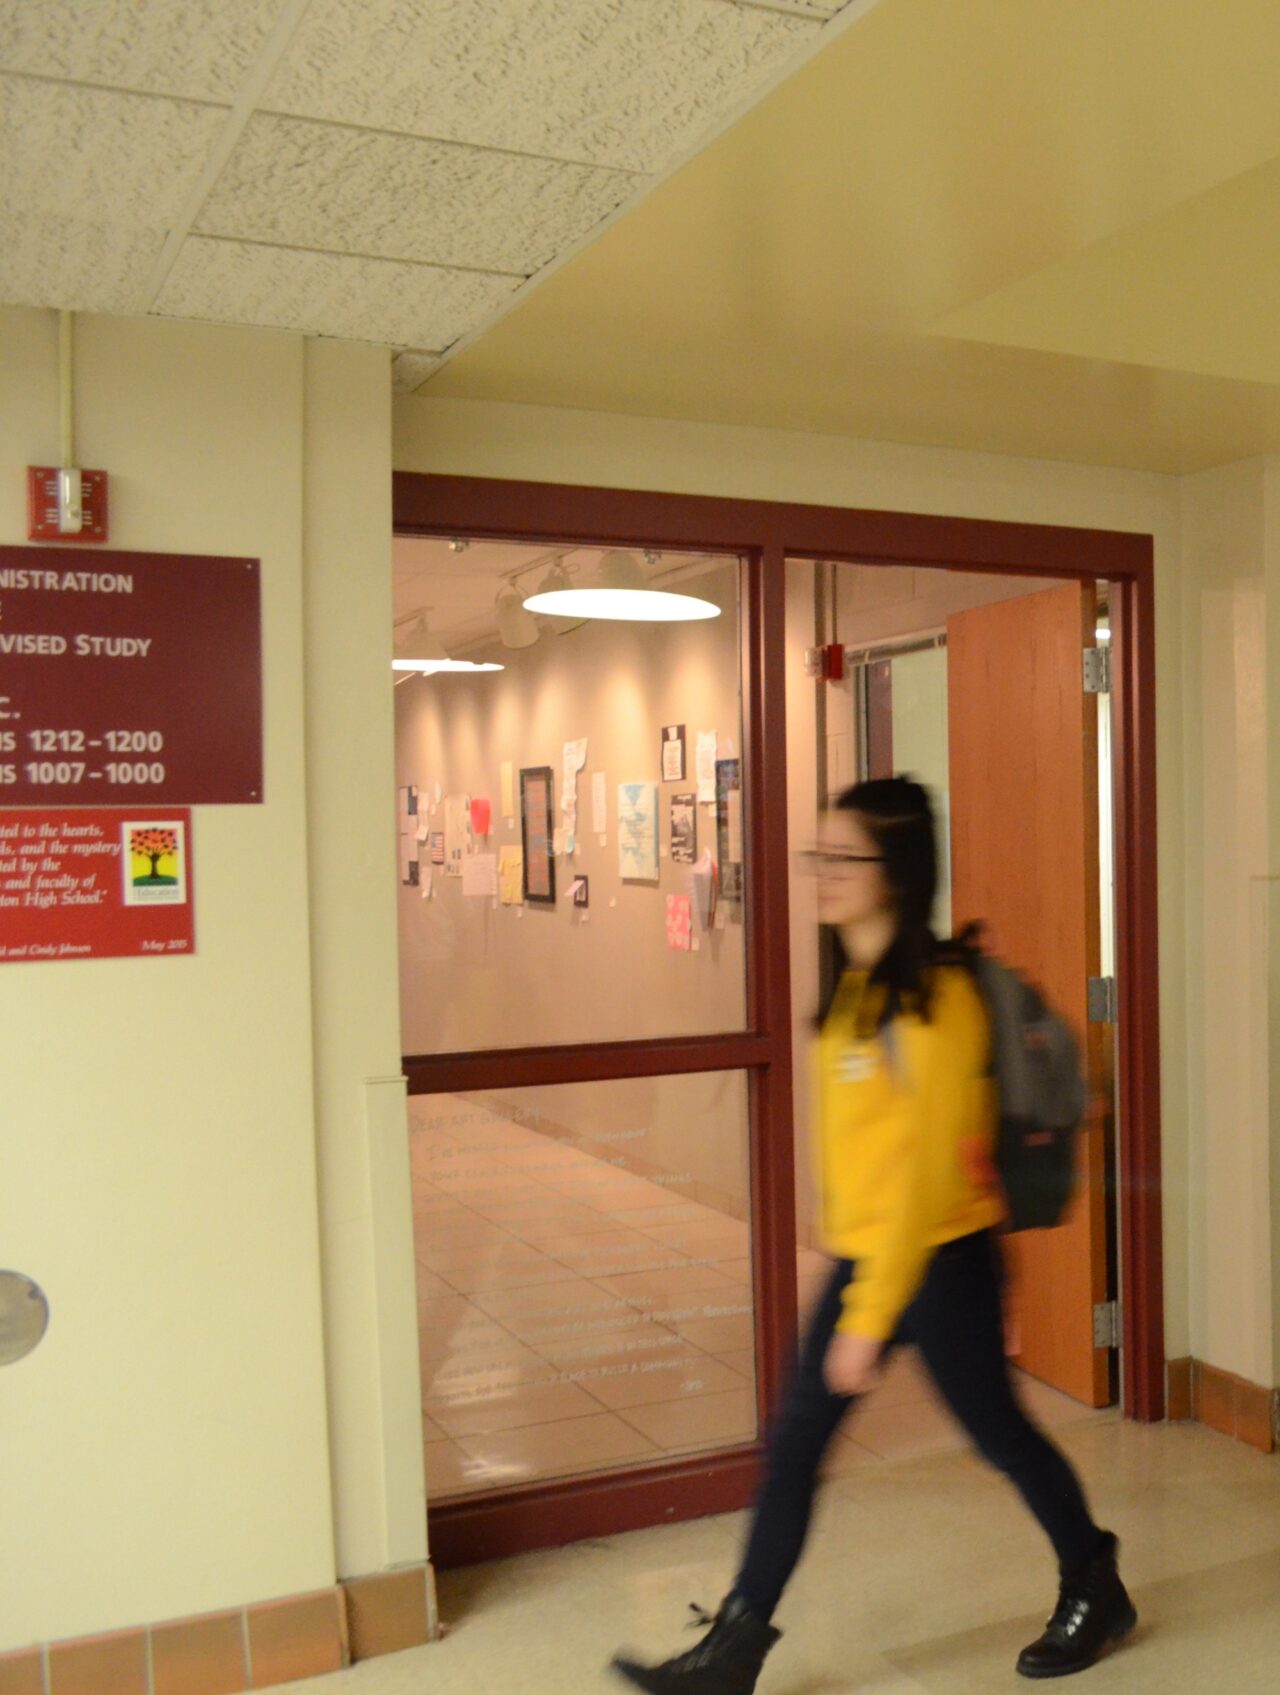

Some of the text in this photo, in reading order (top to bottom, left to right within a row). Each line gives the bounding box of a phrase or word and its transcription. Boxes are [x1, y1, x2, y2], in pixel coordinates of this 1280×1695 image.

[75, 634, 152, 657] STUDY
[24, 825, 36, 838] to
[40, 823, 59, 837] the
[20, 840, 46, 855] and
[50, 840, 69, 854] the
[72, 841, 122, 857] mystery
[21, 858, 38, 875] by
[42, 857, 61, 871] the
[5, 873, 97, 892] and faculty of
[25, 892, 57, 909] High
